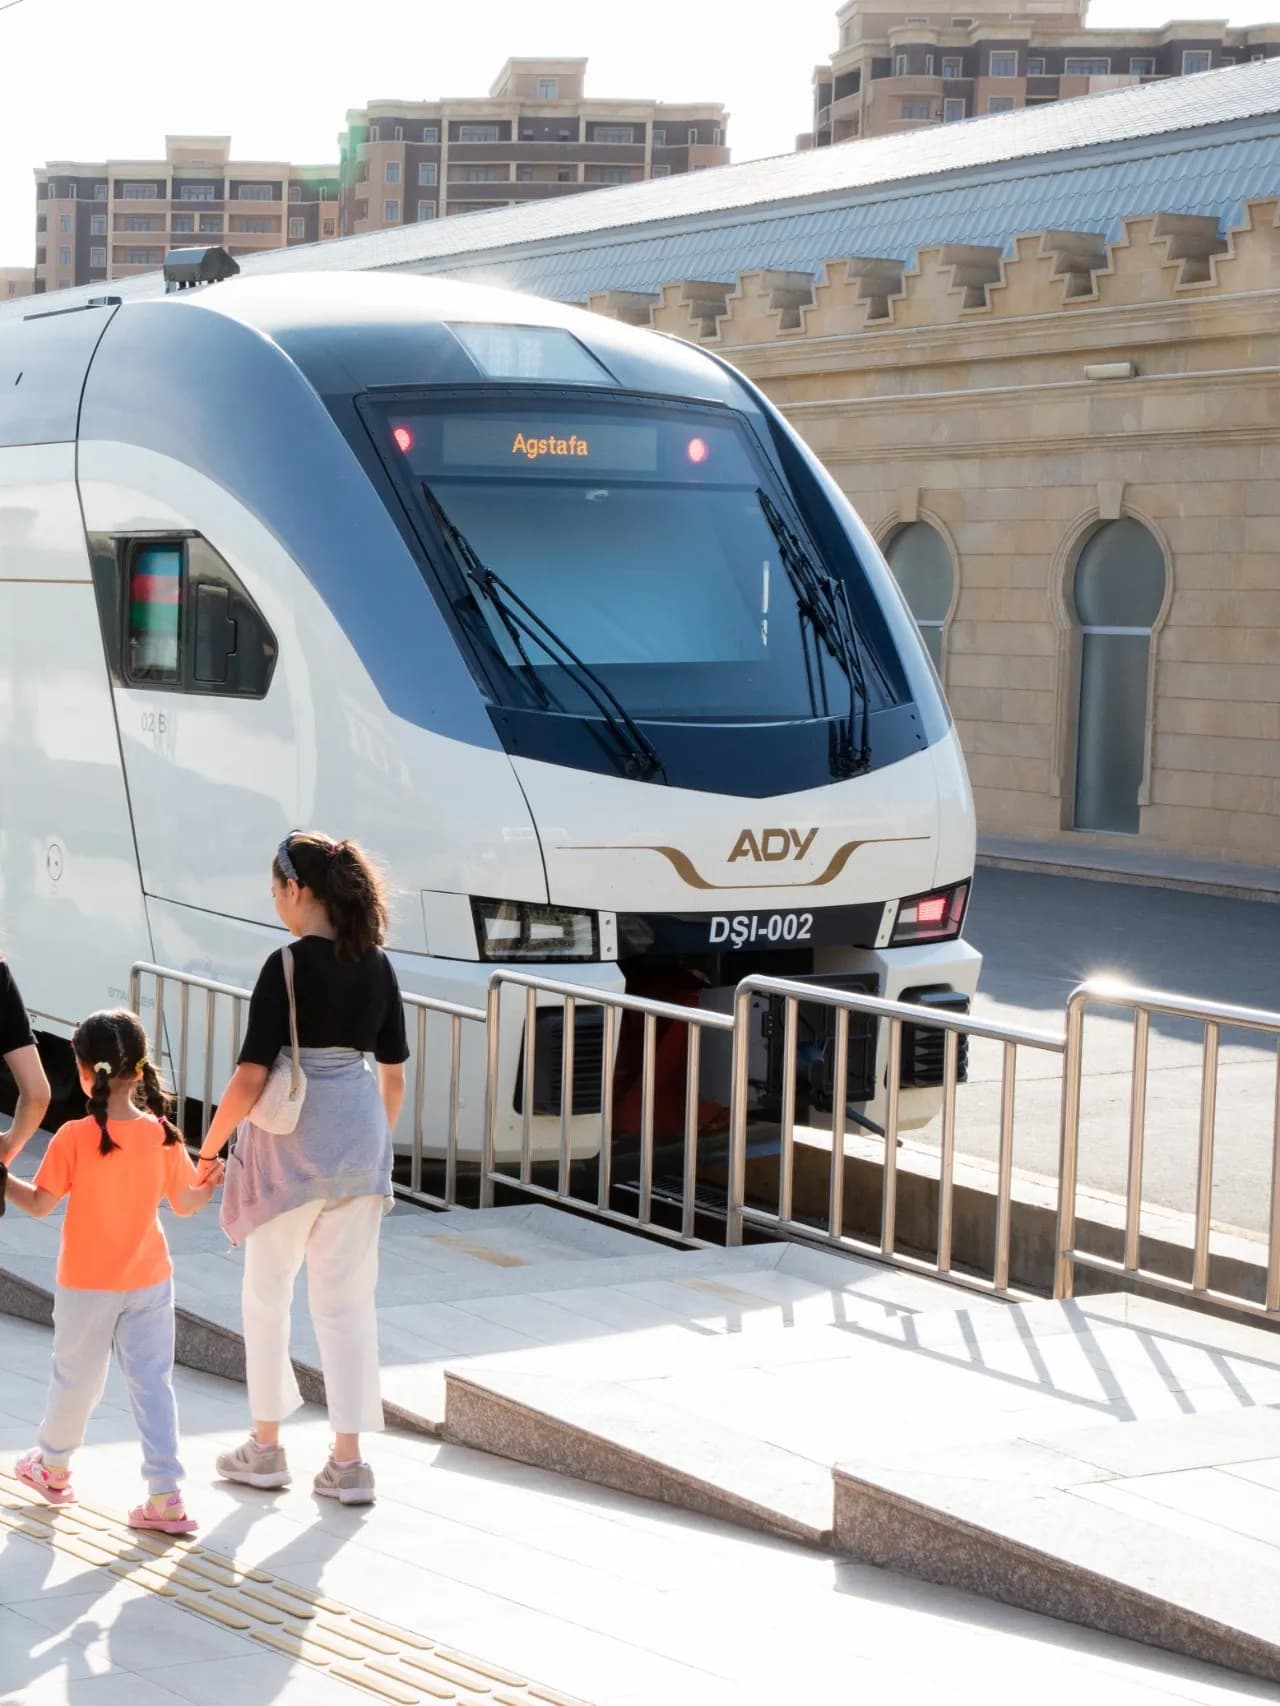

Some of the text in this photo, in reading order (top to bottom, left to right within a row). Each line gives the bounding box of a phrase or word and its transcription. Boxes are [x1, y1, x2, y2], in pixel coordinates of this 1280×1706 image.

[511, 432, 588, 459] Agstafa
[727, 827, 820, 862] ADY
[709, 913, 814, 949] DŞI-002
[107, 986, 155, 1009] STAER
